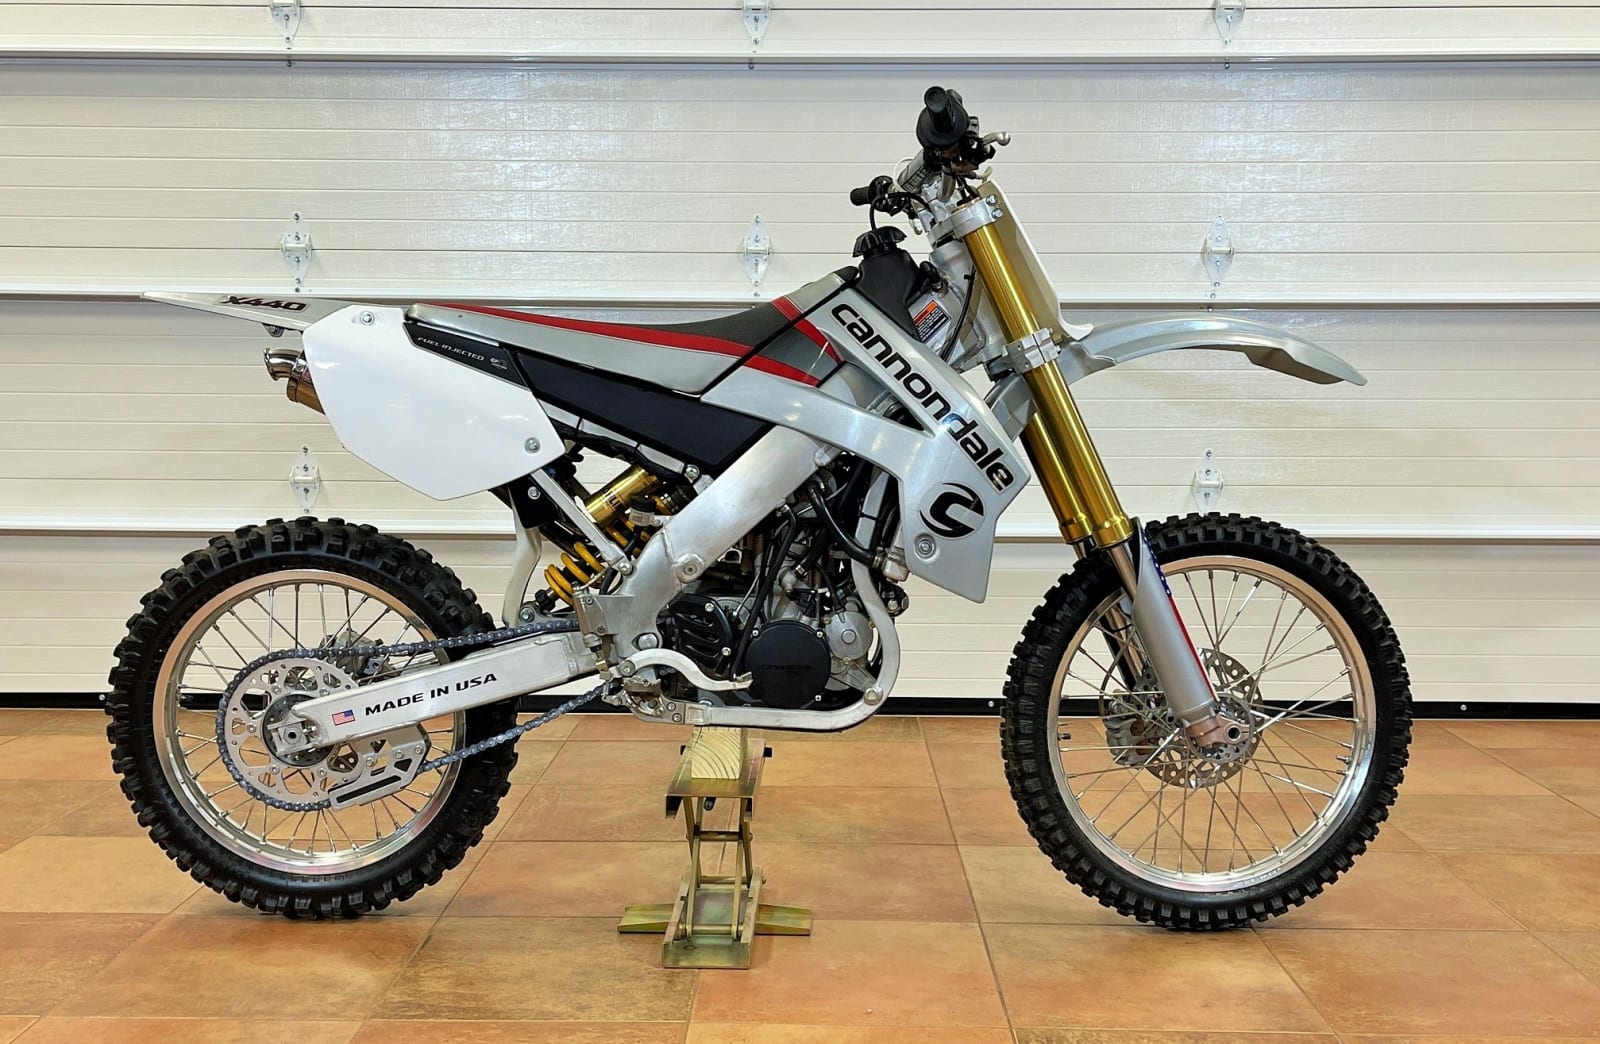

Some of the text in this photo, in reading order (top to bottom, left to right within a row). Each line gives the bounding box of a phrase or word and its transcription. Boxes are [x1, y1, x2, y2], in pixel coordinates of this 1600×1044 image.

[219, 296, 307, 310] X440
[417, 337, 485, 361] FUEL INJECTED
[831, 303, 1014, 491] cannondale
[365, 673, 497, 716] MADE IN USA
